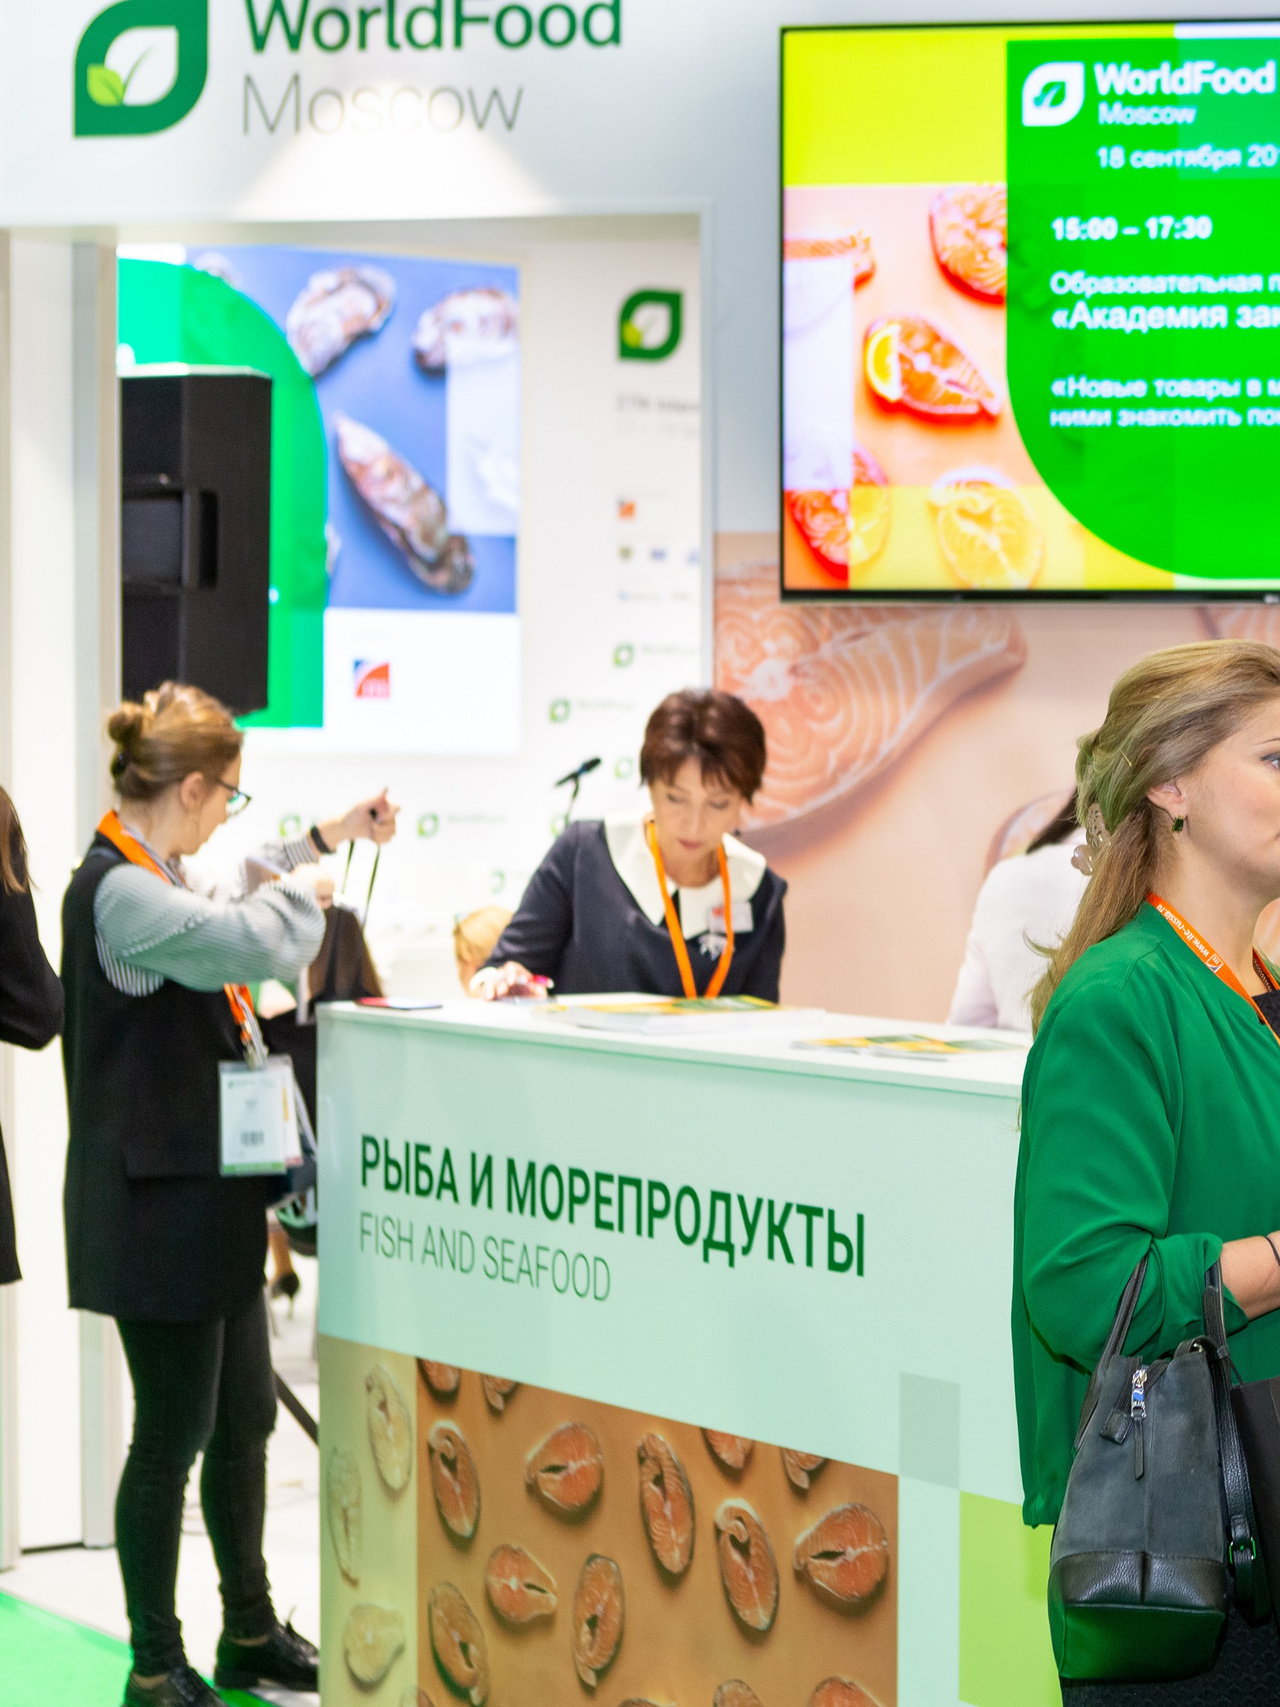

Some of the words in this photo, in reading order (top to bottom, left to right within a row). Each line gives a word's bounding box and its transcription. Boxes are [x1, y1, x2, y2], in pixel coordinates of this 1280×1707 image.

[244, 0, 622, 54] WorldFood
[1093, 59, 1277, 95] WorldFood
[243, 72, 523, 136] Moscow
[1098, 100, 1198, 125] Moscow
[1097, 144, 1126, 168] 18
[1129, 143, 1242, 173] сентября
[1051, 215, 1119, 241] 15:00
[1145, 214, 1213, 240] 17:30
[1050, 270, 1264, 299] Образовательная
[1051, 299, 1228, 334] «Академия
[1050, 375, 1148, 398] «Новые
[1153, 377, 1242, 402] товары
[1246, 379, 1262, 397] в
[1050, 409, 1111, 427] ними
[1117, 407, 1243, 427] знакомить
[1156, 903, 1210, 958] www.ite-russia.ru
[361, 1134, 460, 1204] РЫБА
[471, 1150, 494, 1210] И
[507, 1156, 865, 1278] МОРЕПРОДУКТЫ
[360, 1211, 415, 1263] FISH
[421, 1224, 476, 1275] AND
[482, 1235, 611, 1302] SEAFOOD
